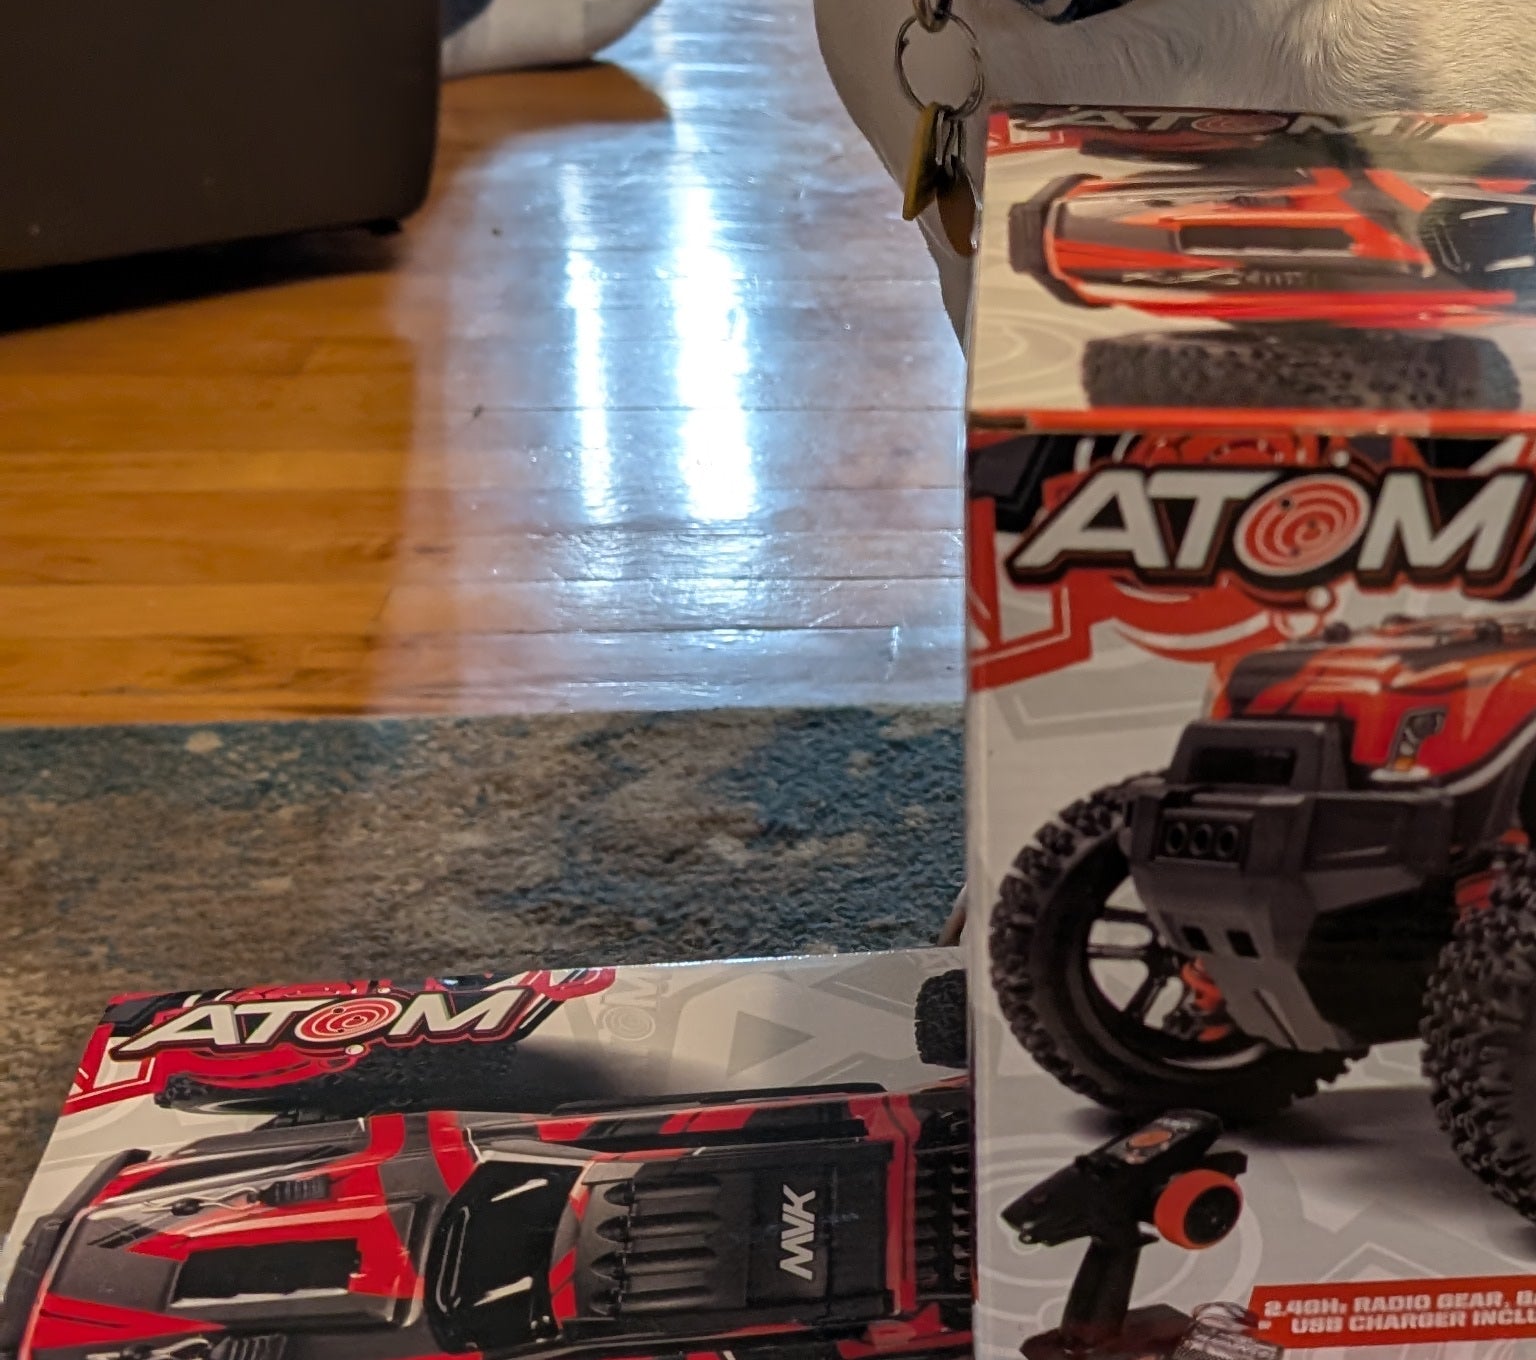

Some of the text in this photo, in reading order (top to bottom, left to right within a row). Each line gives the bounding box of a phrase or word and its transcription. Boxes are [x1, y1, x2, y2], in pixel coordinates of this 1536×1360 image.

[1040, 107, 1405, 137] ATOM
[1012, 469, 1530, 578] ATOM
[120, 989, 531, 1051] ATOM
[1354, 1294, 1431, 1314] RADIO
[1291, 1316, 1343, 1334] USB
[1349, 1311, 1467, 1332] CHARGER
